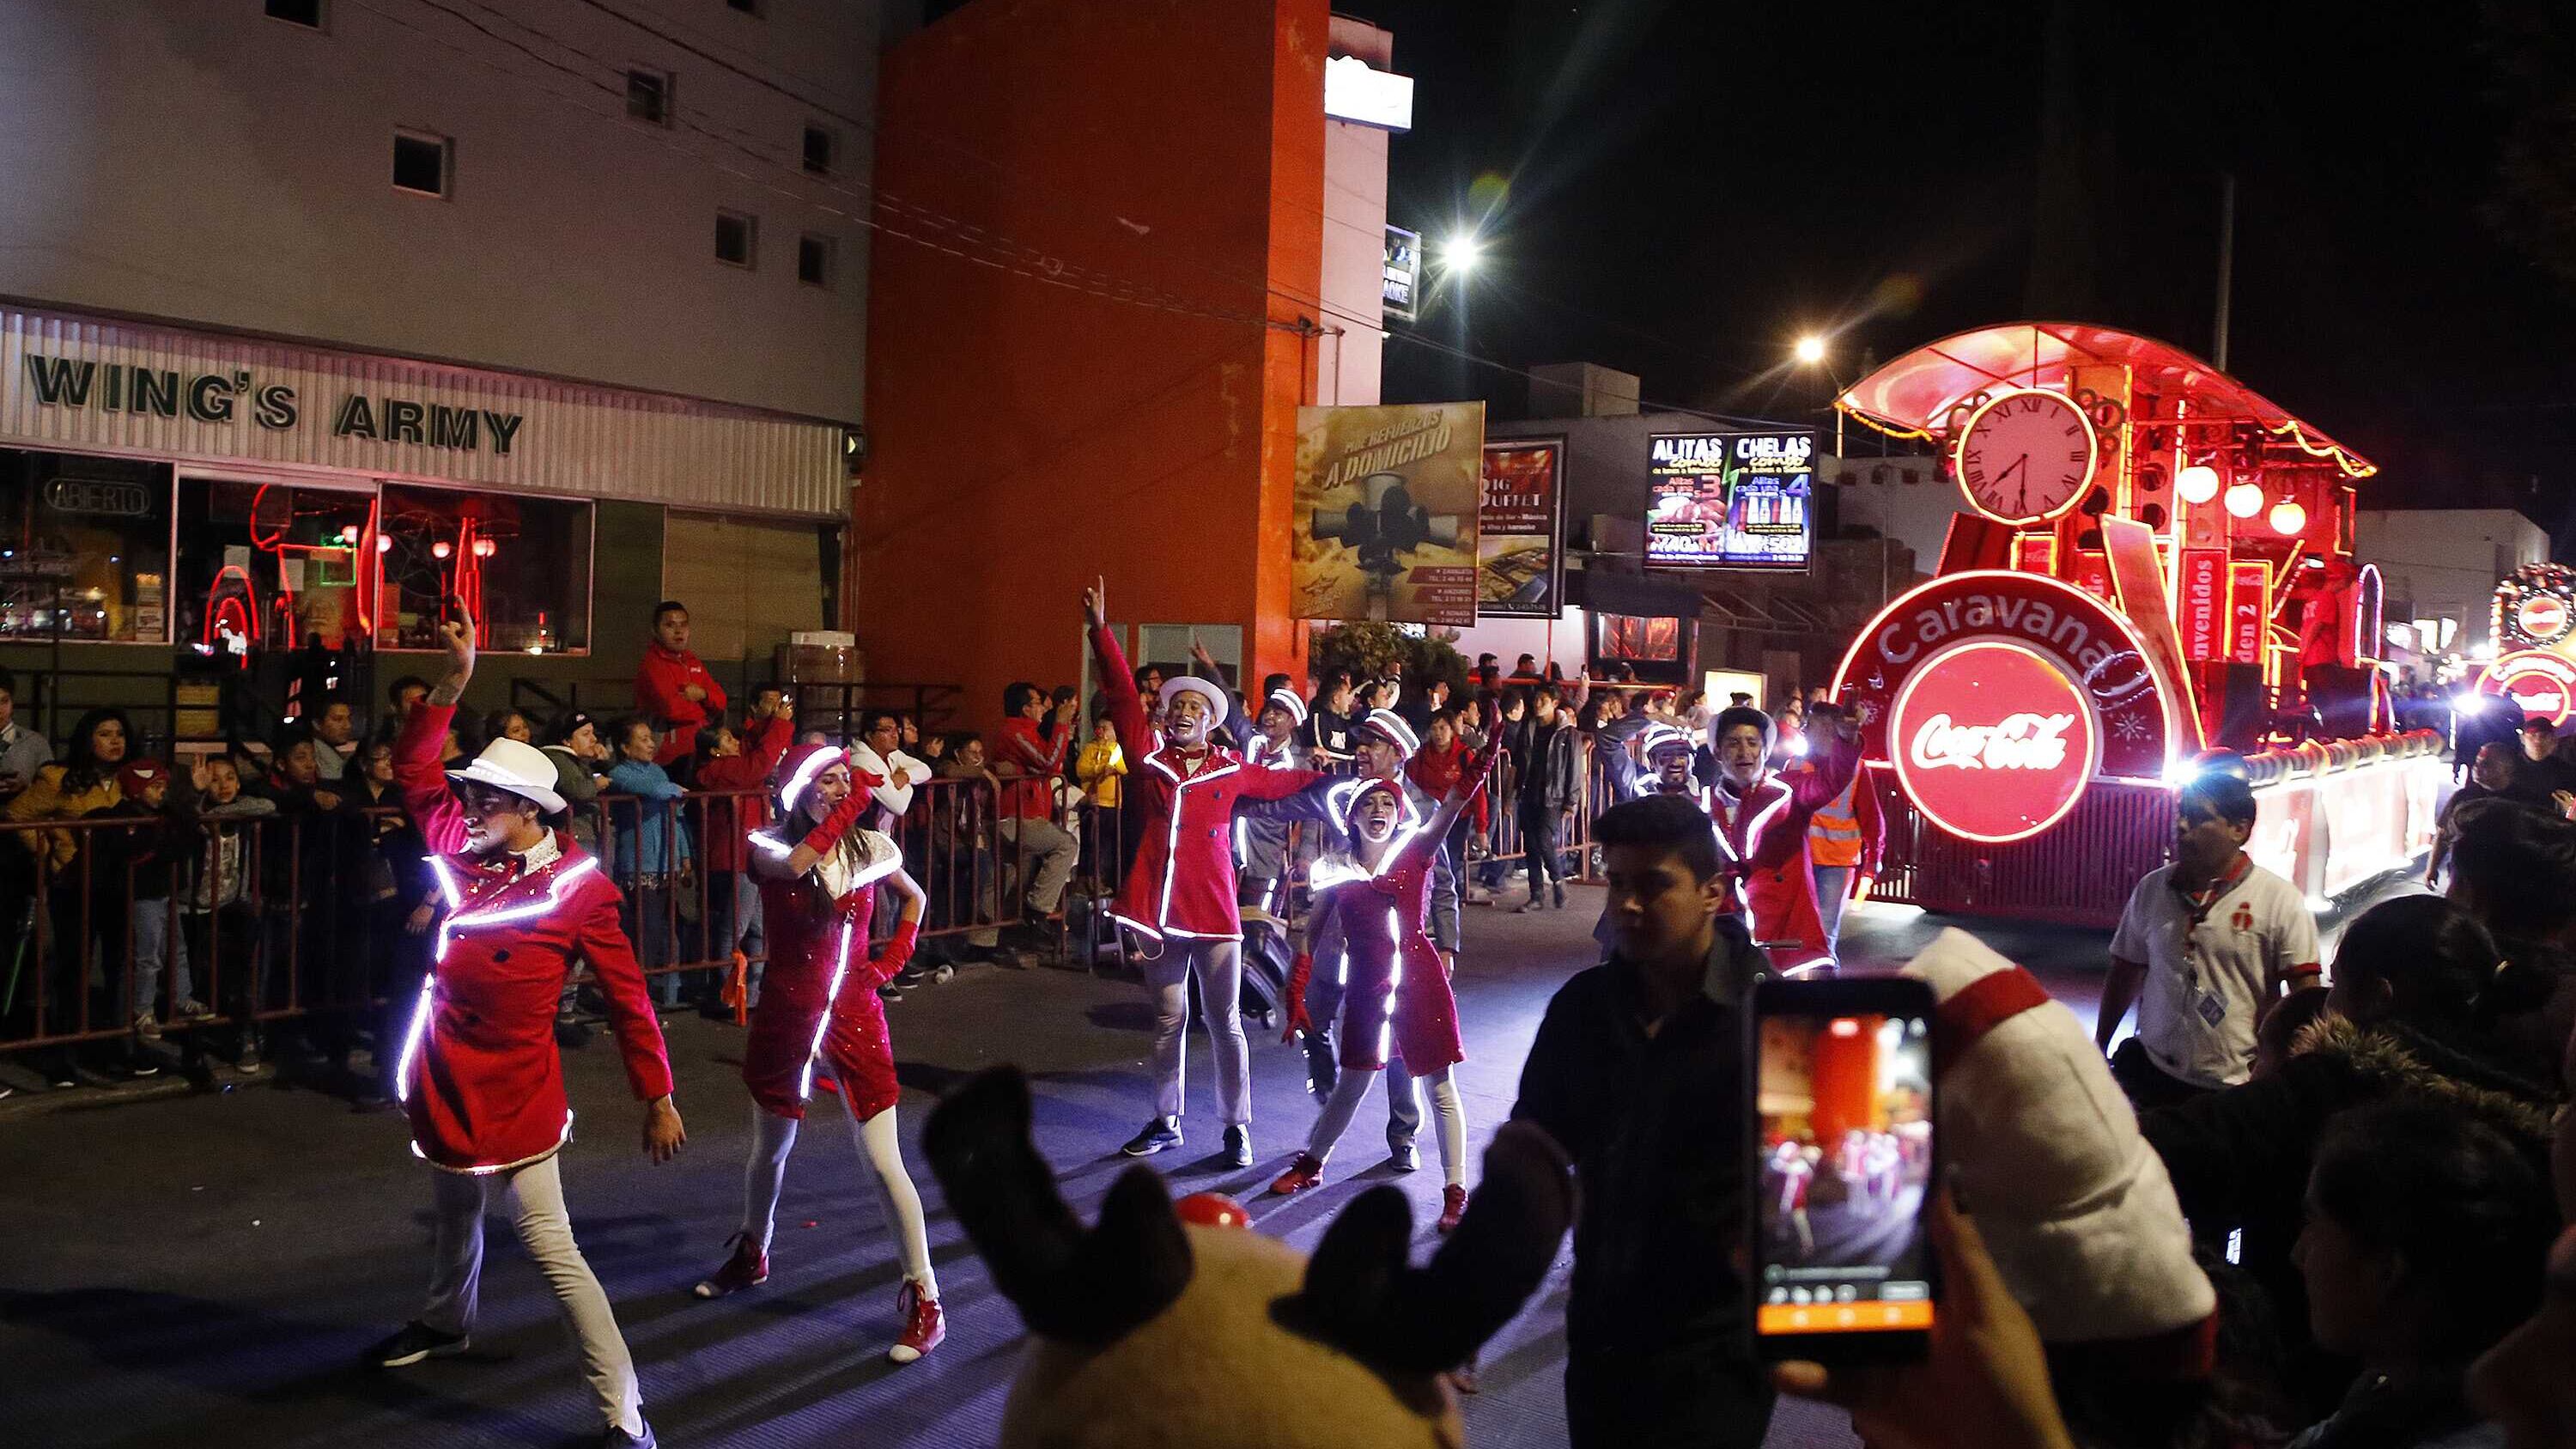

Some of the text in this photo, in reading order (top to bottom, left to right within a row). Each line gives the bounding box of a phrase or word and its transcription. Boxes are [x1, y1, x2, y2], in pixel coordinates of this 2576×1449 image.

[27, 354, 523, 454] WING'S ARMY
[1342, 424, 1452, 485] DOMICILIO
[1652, 438, 1722, 460] ALITAS
[1736, 436, 1811, 459] CHELAS
[2070, 451, 2085, 462] III
[54, 482, 146, 514] ABIERTO
[1878, 594, 2118, 668] Caravana
[2190, 559, 2213, 661] nvenidos
[1911, 712, 2075, 770] Coca-Cola
